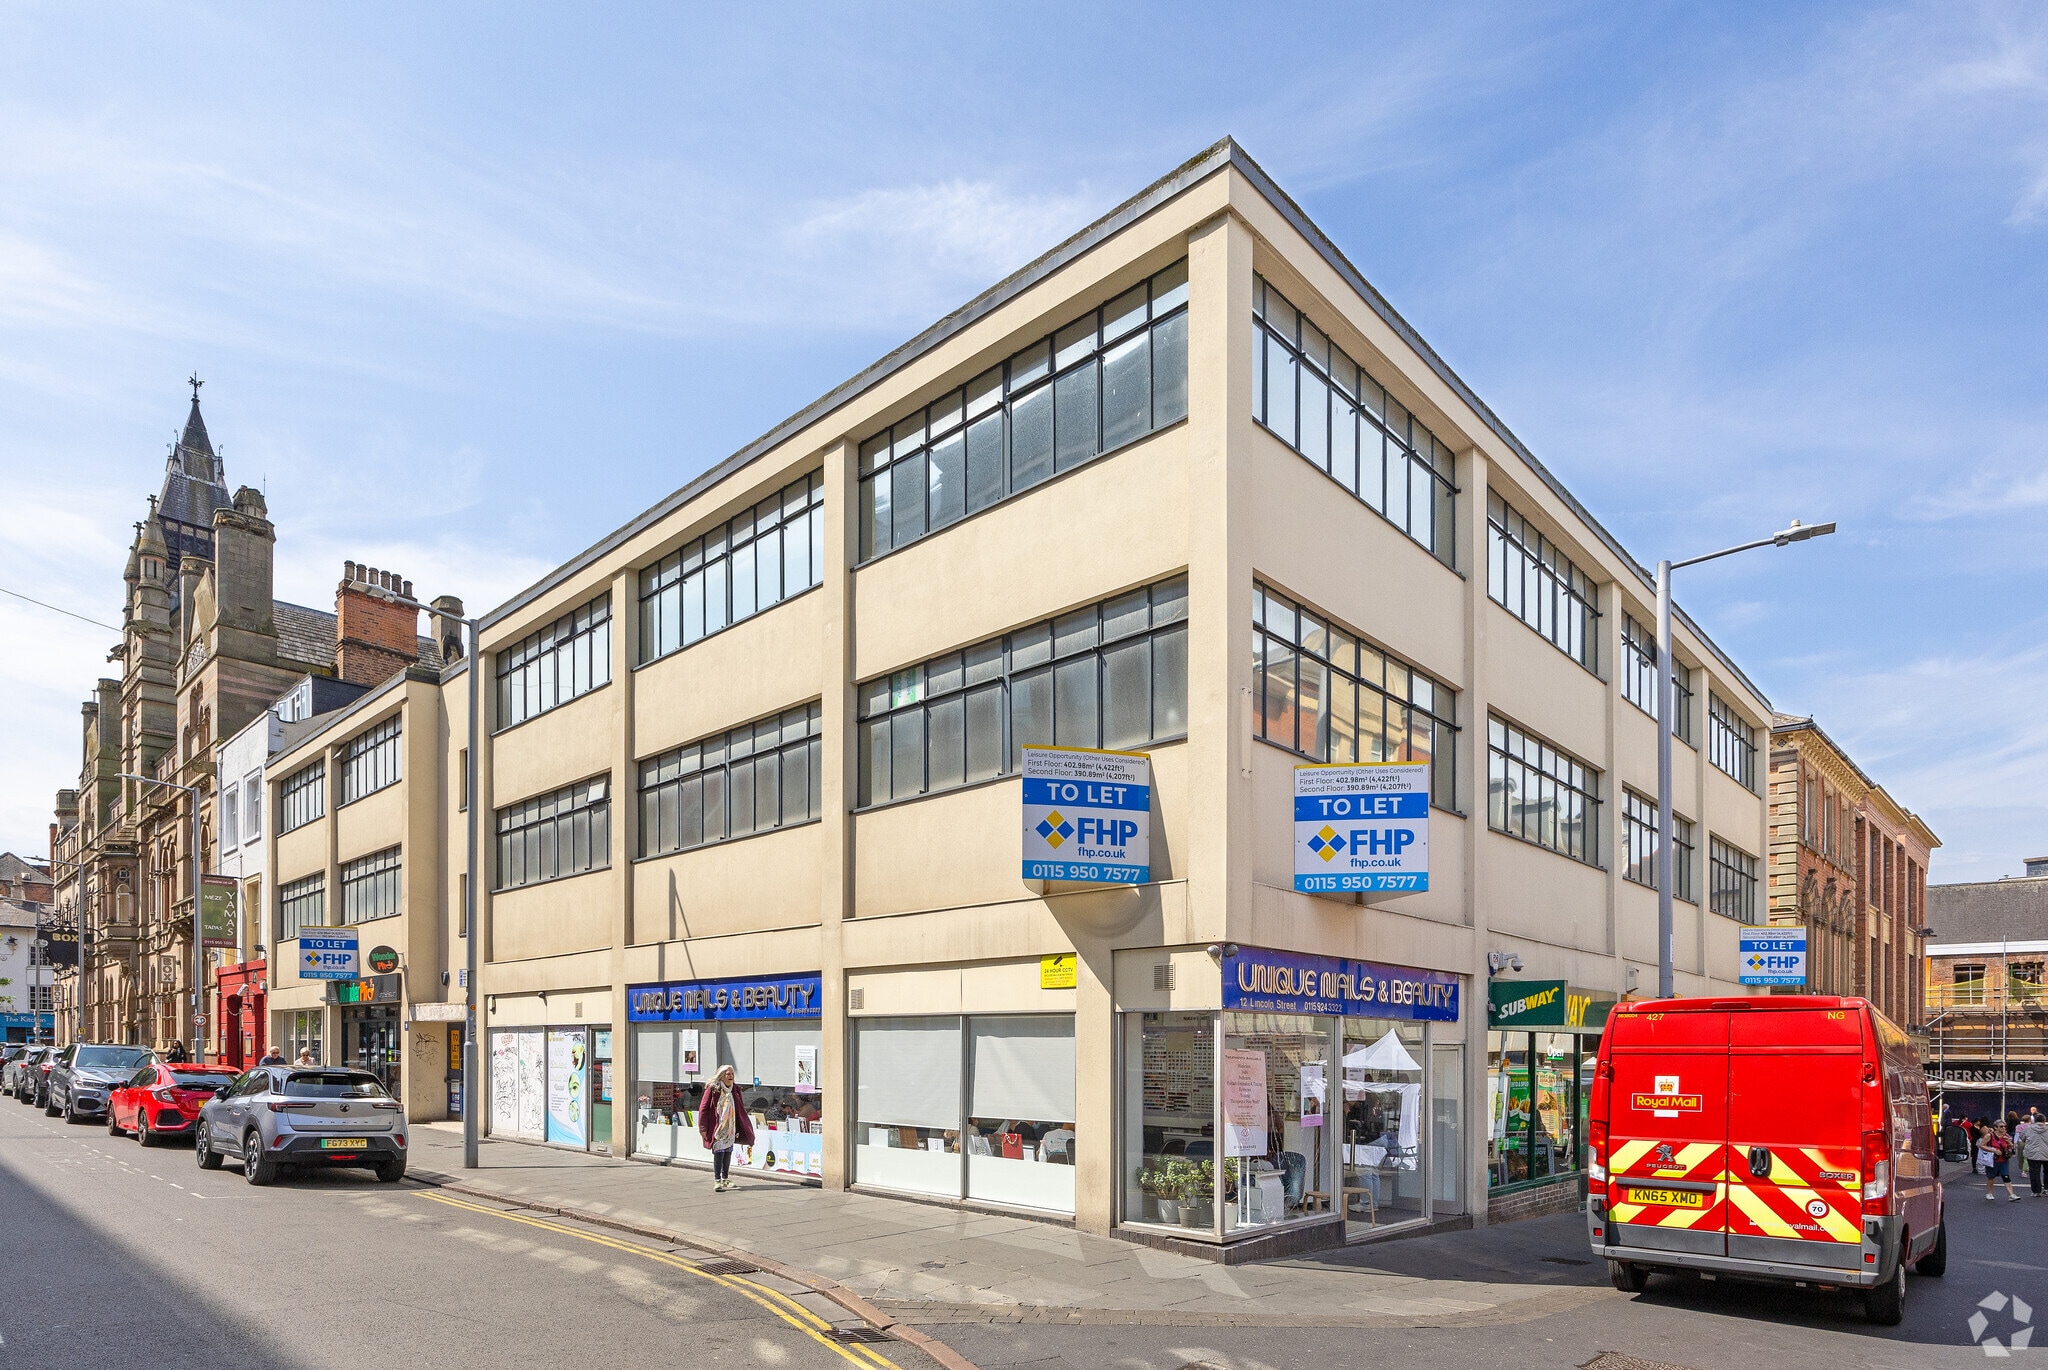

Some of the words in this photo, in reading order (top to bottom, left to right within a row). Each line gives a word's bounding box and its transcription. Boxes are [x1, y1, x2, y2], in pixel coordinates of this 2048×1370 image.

[1027, 751, 1047, 759] Leisure
[1049, 752, 1082, 761] Opportunity
[1083, 754, 1100, 762] (Other
[1115, 757, 1146, 766] Considered)
[1320, 769, 1355, 777] Opportunity
[1315, 777, 1335, 785] Floor:
[1046, 782, 1079, 802] TO
[1087, 785, 1127, 805] LET
[1299, 785, 1325, 793] Second
[1318, 798, 1351, 816] TO
[1360, 797, 1403, 815] LET
[1077, 817, 1138, 846] FHP
[1350, 829, 1415, 855] FHP
[1077, 847, 1126, 859] fhp.co.uk
[1350, 857, 1401, 869] fhp.co.uk
[1032, 864, 1064, 878] 0115
[1069, 866, 1099, 879] 950
[1103, 867, 1140, 881] 7577
[1304, 877, 1337, 890] 0115
[1341, 876, 1372, 889] 950
[1377, 876, 1417, 888] 7577
[224, 891, 236, 936] YAMAS
[52, 933, 78, 943] BOX
[310, 940, 324, 948] TO
[327, 940, 347, 949] LET
[1752, 941, 1769, 950] TO
[1772, 941, 1794, 950] LET
[323, 953, 352, 965] FHP
[1767, 956, 1800, 969] FHP
[162, 957, 173, 981] BOX
[1238, 962, 1317, 997] UNIQUE
[1320, 971, 1374, 1002] NAILS
[1377, 980, 1389, 1003] &
[1391, 979, 1454, 1008] BEAUTY
[633, 988, 682, 1014] UNIQUE
[684, 987, 728, 1012] NAILS
[730, 989, 742, 1011] &
[743, 982, 814, 1009] BEAUTY
[1239, 998, 1248, 1007] 12
[1250, 999, 1274, 1010] Lincoln
[1276, 1001, 1297, 1011] Street
[1499, 986, 1559, 1020] SUBWAY
[5, 1015, 19, 1023] The
[20, 1015, 47, 1023] Kitcen
[1646, 1013, 1665, 1021] 427
[1827, 1011, 1845, 1020] NG
[453, 1033, 459, 1041] TO
[1547, 1045, 1564, 1058] Open
[1924, 1069, 2034, 1082] URGER&SAUCE
[1636, 1096, 1669, 1108] Royal
[1671, 1097, 1697, 1108] Mail
[326, 1139, 348, 1147] FG73
[349, 1139, 366, 1147] XYC
[1819, 1171, 1853, 1180] BOXER
[1634, 1189, 1667, 1202] KN65
[1671, 1191, 1697, 1205] XMO
